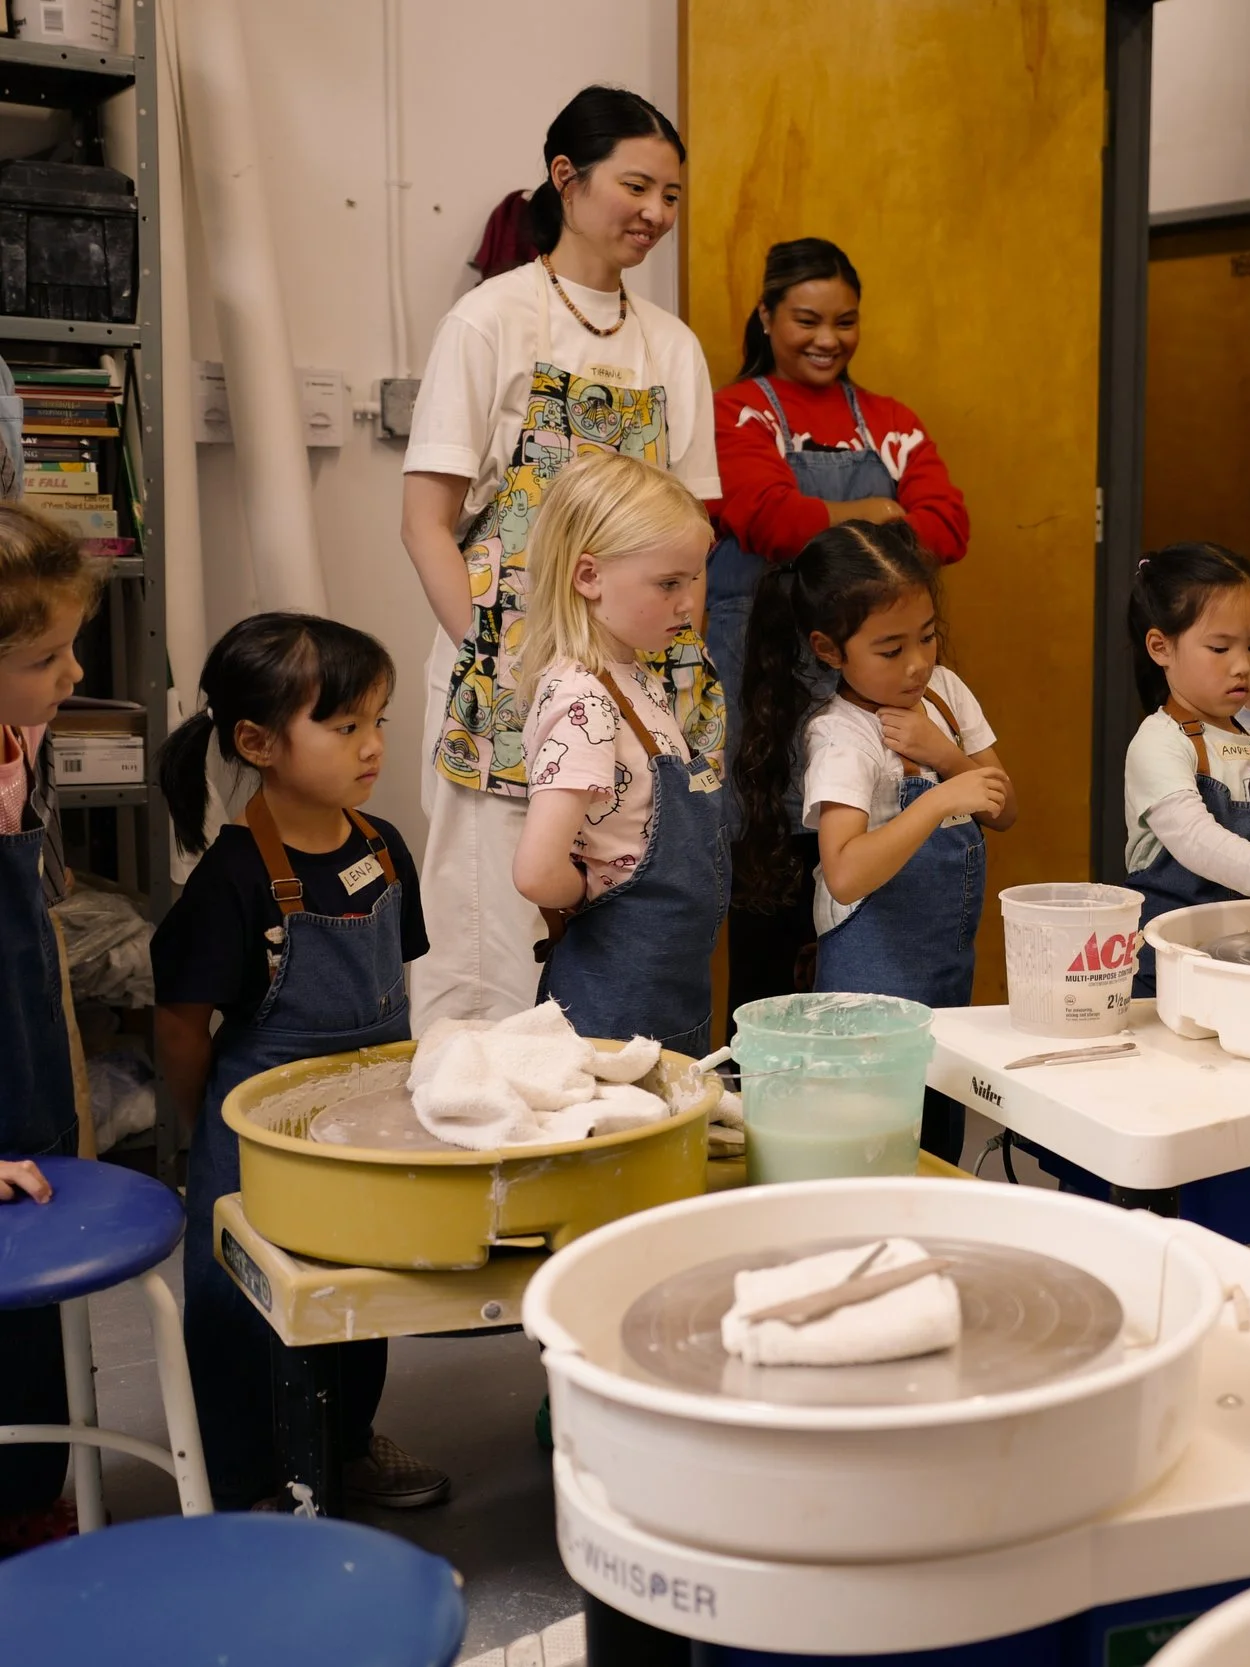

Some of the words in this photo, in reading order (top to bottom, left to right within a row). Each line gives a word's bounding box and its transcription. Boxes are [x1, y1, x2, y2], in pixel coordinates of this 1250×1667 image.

[39, 478, 69, 488] FALL
[1222, 744, 1250, 757] ANDIE
[343, 861, 373, 888] LENA
[1067, 931, 1137, 971] ACE
[1065, 973, 1117, 982] MULTI-PURPOSE
[970, 1075, 1006, 1109] Nidec
